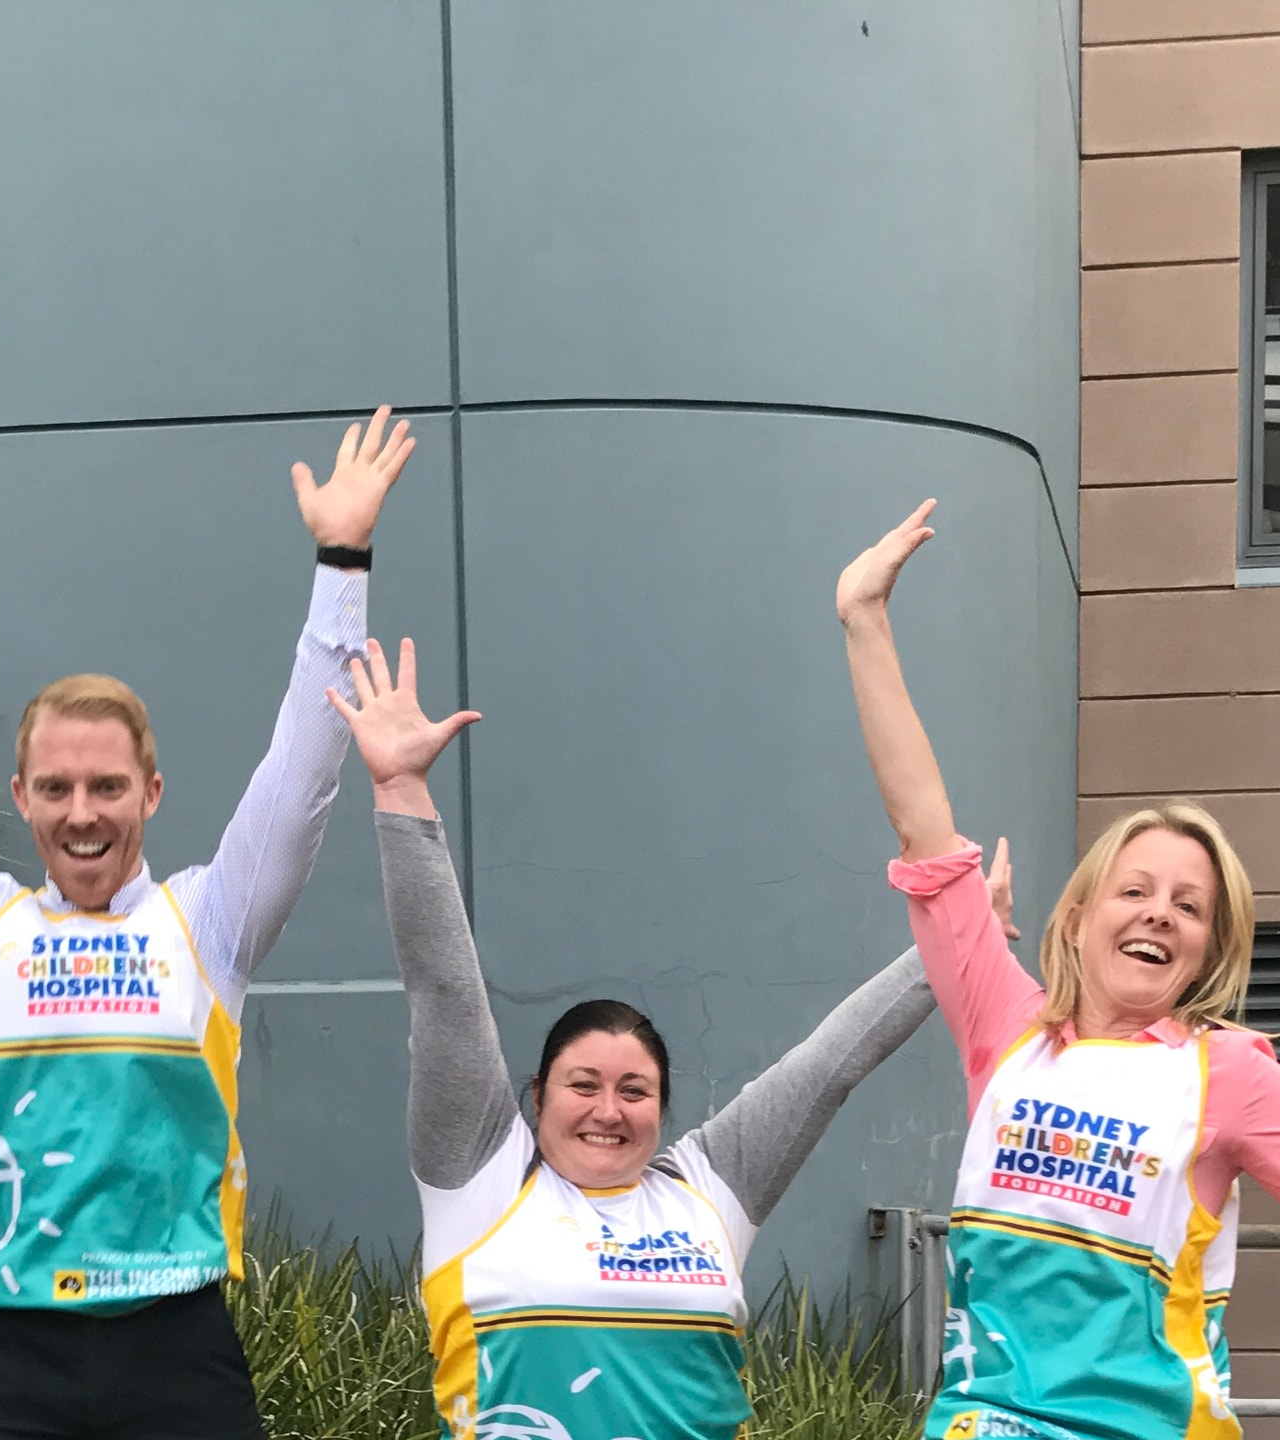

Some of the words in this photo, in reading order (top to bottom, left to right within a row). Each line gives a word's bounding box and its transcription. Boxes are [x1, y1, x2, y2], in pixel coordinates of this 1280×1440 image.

[31, 933, 151, 955] SYDNEY
[17, 956, 170, 980] CHILDREN'S
[28, 977, 160, 1000] HOSPITAL
[1011, 1098, 1150, 1146] SYDNEY
[996, 1124, 1162, 1178] CHILDREN'S
[995, 1148, 1136, 1199] HOSPITAL
[998, 1175, 1123, 1213] FOUNDATION
[599, 1253, 723, 1273] HOSPITAL
[87, 1268, 124, 1287] THE
[128, 1266, 200, 1286] INCOME
[607, 1271, 723, 1285] FOUNDATION
